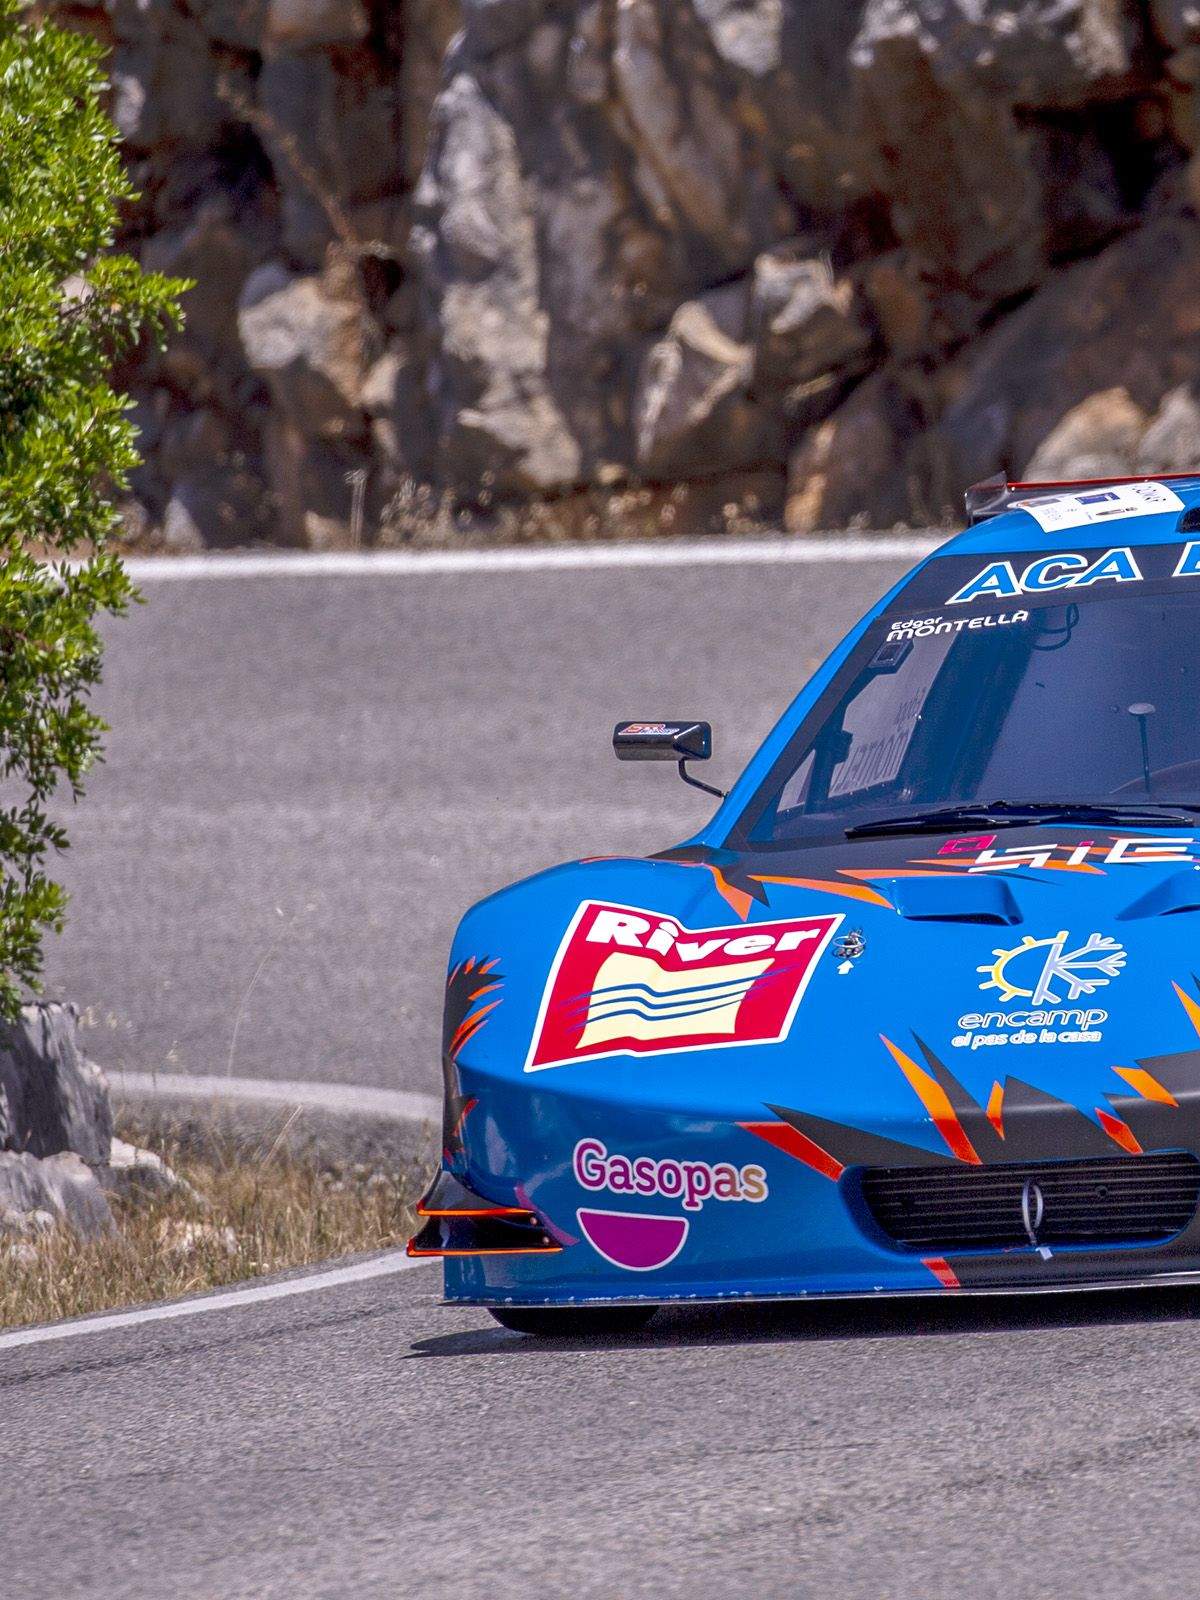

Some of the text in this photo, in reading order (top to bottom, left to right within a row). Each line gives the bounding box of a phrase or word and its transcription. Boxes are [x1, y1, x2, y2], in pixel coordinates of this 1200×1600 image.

[945, 547, 1143, 604] ACA
[891, 616, 943, 631] Edgar
[586, 910, 820, 962] River
[958, 1009, 1108, 1030] encamp
[951, 1029, 1102, 1050] el pas de la casa
[574, 1138, 769, 1210] Gasopas
